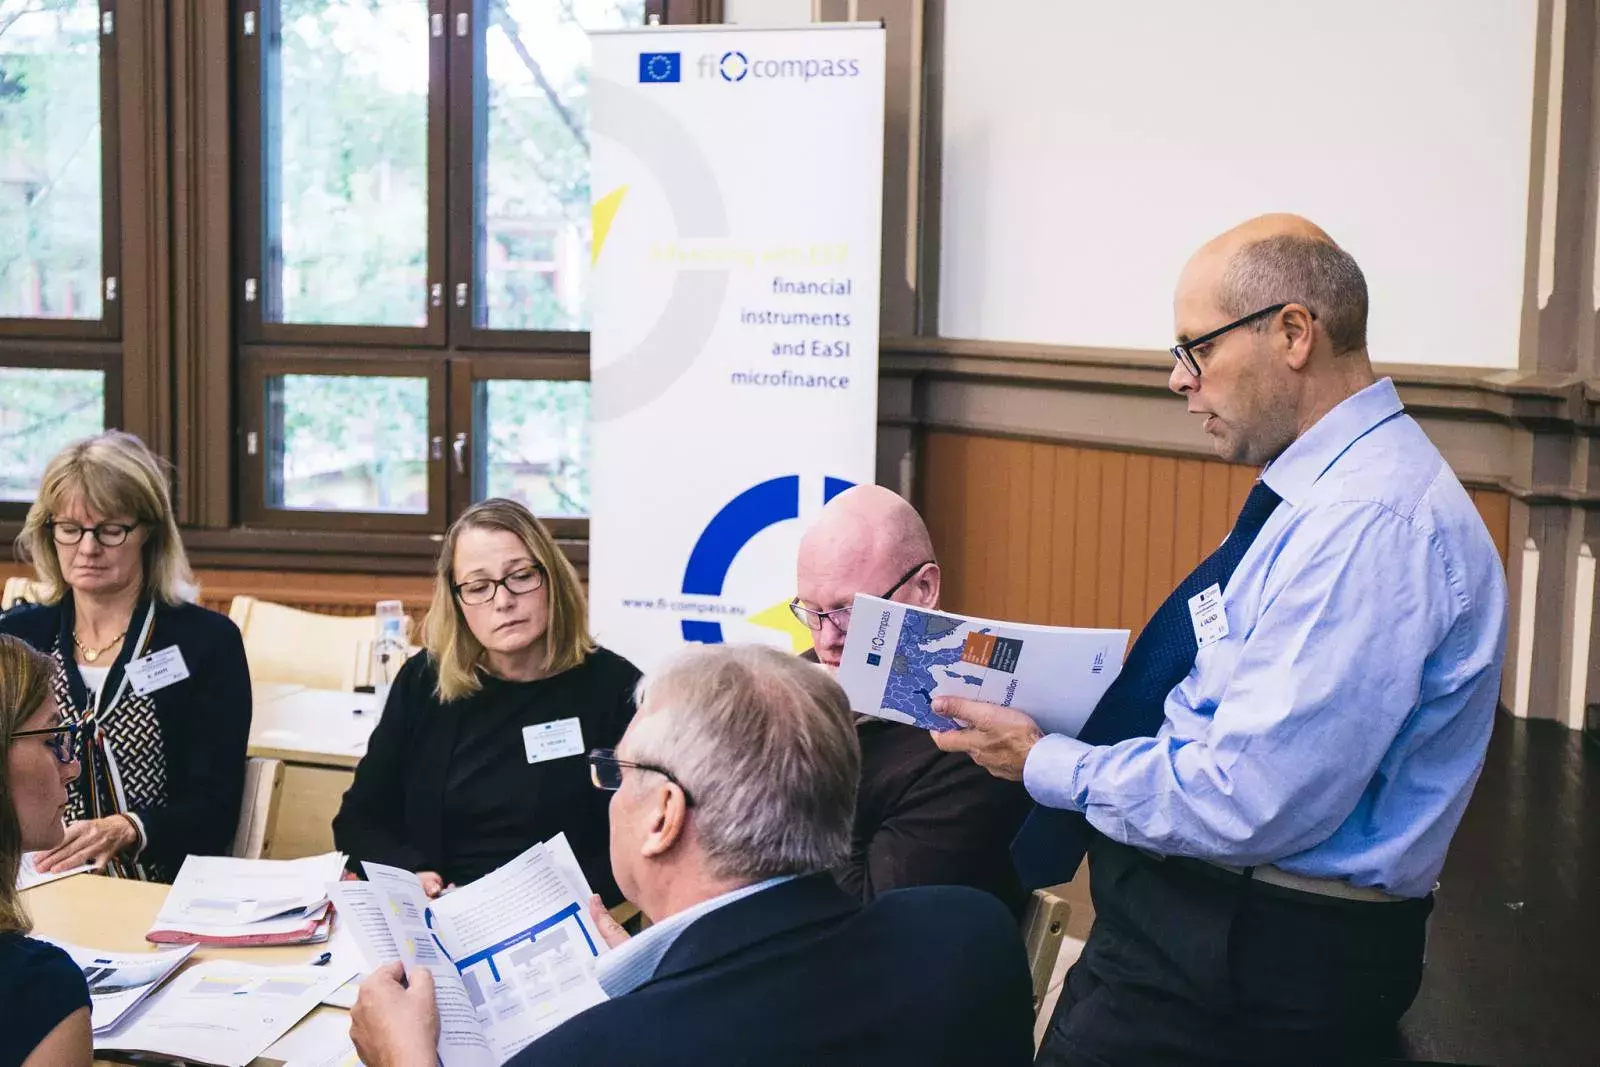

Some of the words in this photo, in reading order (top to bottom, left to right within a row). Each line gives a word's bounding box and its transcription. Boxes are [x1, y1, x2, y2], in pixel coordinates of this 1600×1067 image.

[752, 57, 860, 82] compass
[772, 276, 851, 296] financial
[740, 307, 851, 327] instruments
[771, 340, 806, 357] and
[811, 341, 850, 357] EaSI
[730, 369, 849, 389] microfinance
[621, 597, 746, 616] www.fi-compass.eu
